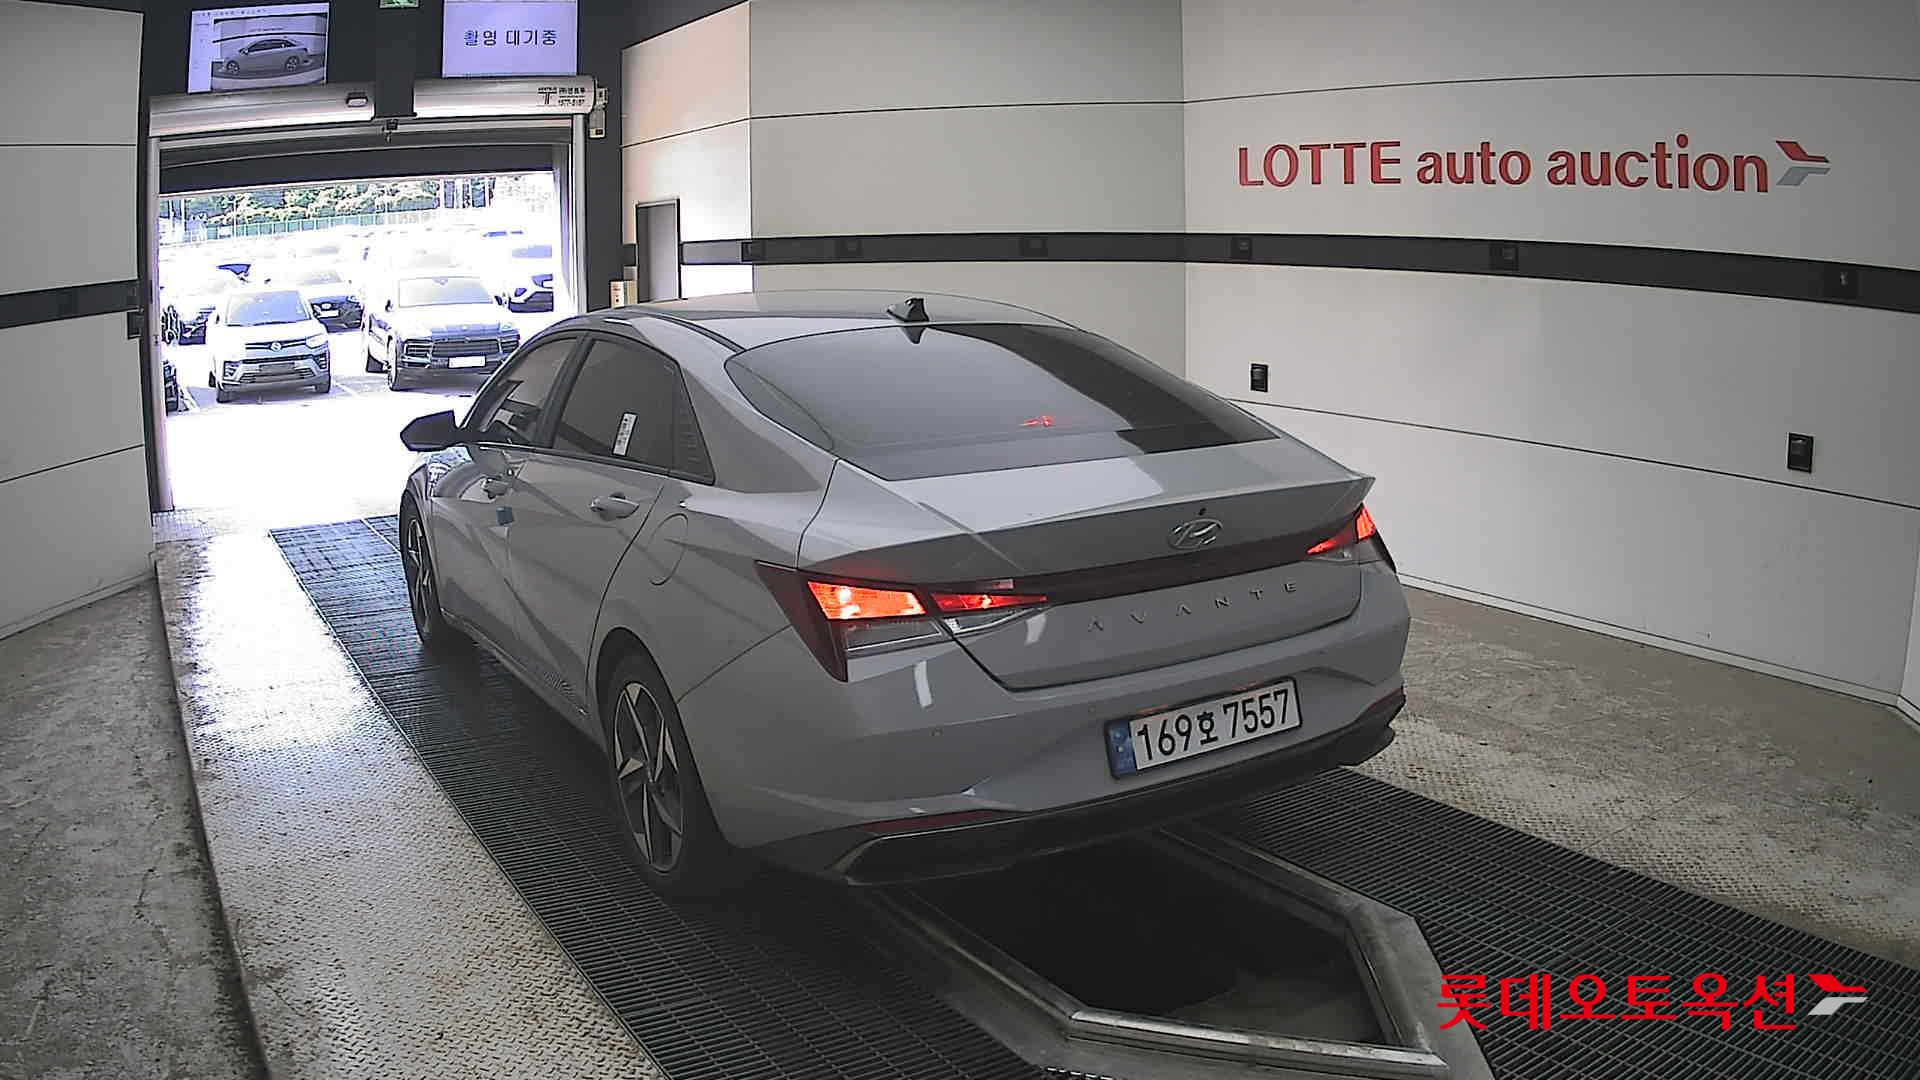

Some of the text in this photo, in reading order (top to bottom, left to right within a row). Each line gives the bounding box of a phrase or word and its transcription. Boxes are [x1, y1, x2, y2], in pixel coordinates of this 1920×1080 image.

[505, 29, 558, 46] 대기중
[1239, 133, 1769, 193] LOTTE auto auction
[1087, 582, 1297, 633] AVANTE
[1137, 688, 1289, 761] 169호 7557
